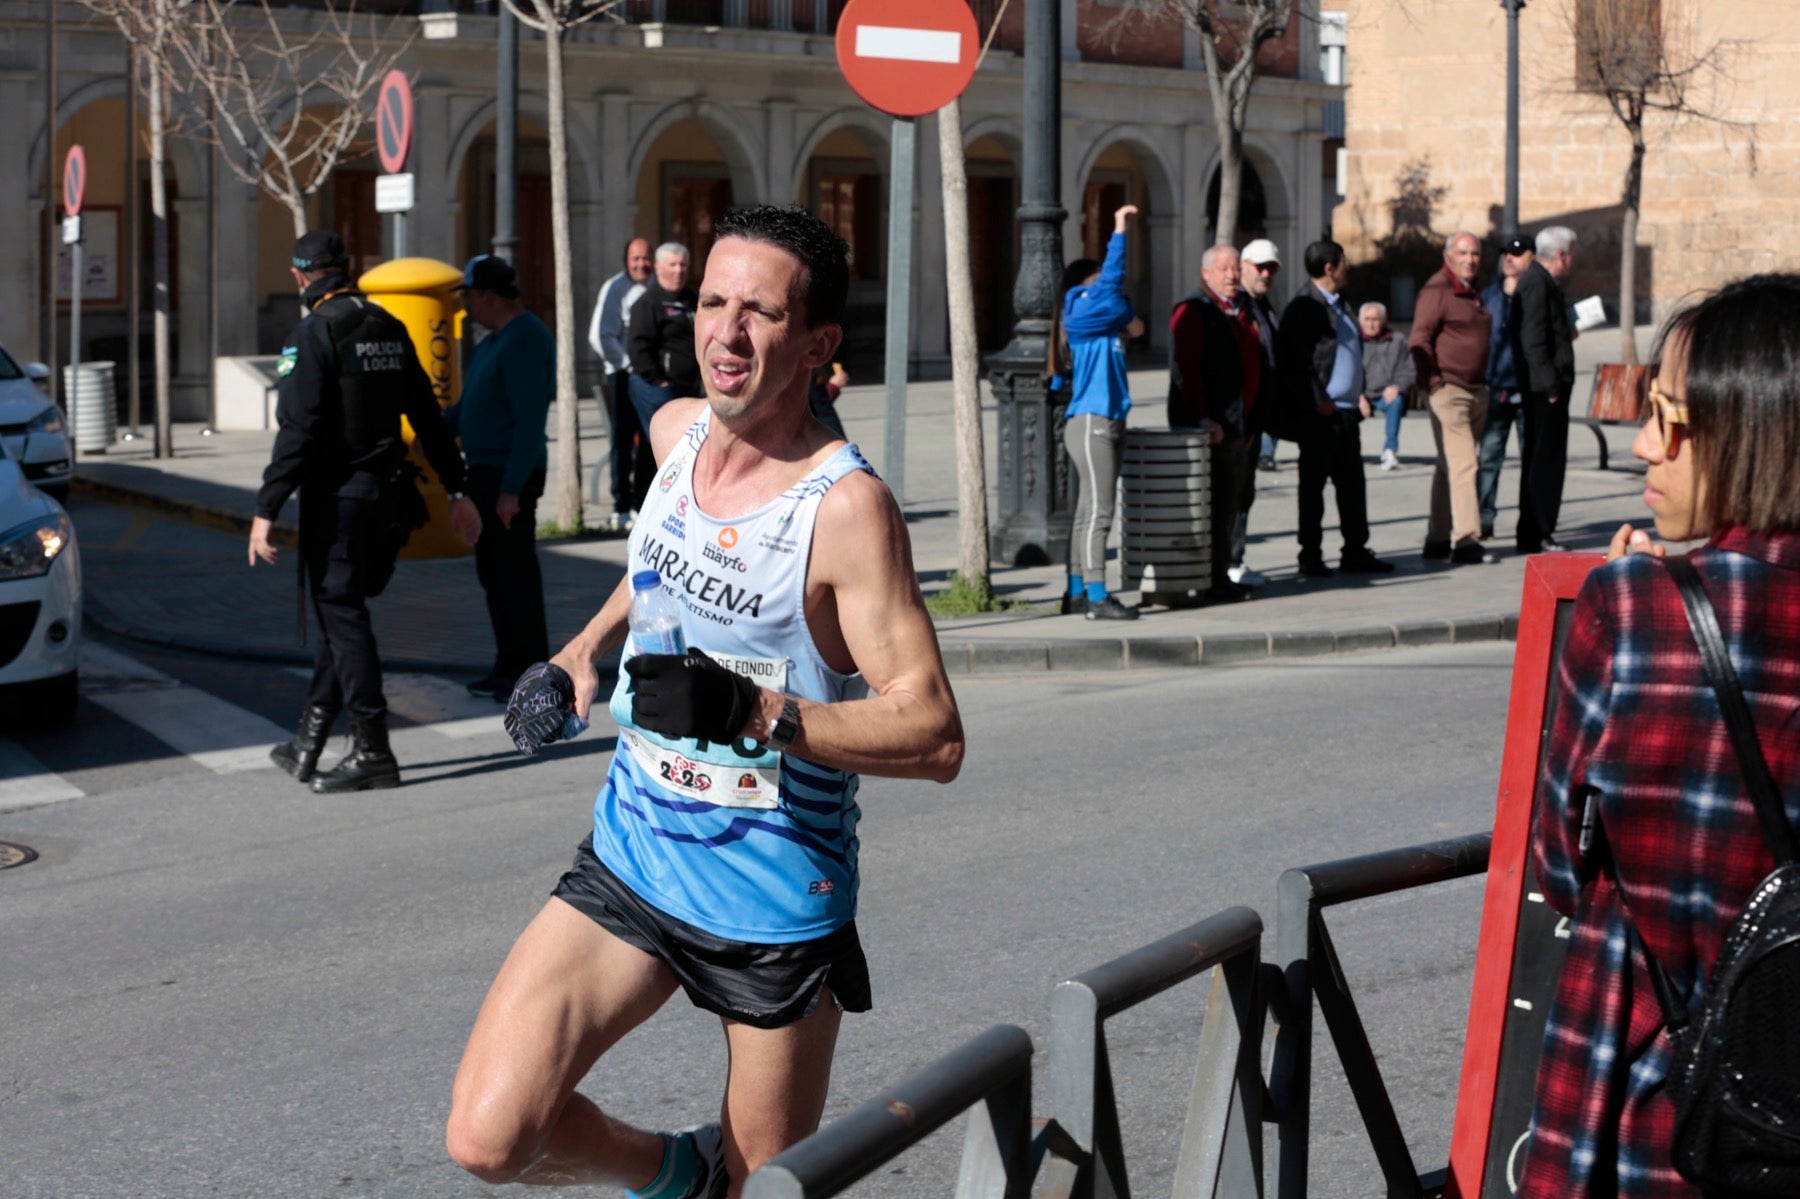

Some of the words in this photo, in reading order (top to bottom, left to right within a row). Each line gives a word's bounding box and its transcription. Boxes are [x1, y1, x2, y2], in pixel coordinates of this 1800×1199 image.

[363, 357, 403, 371] LOCAL
[701, 547, 748, 573] mayfo
[638, 533, 763, 618] MARACENA
[735, 660, 774, 677] FONDO
